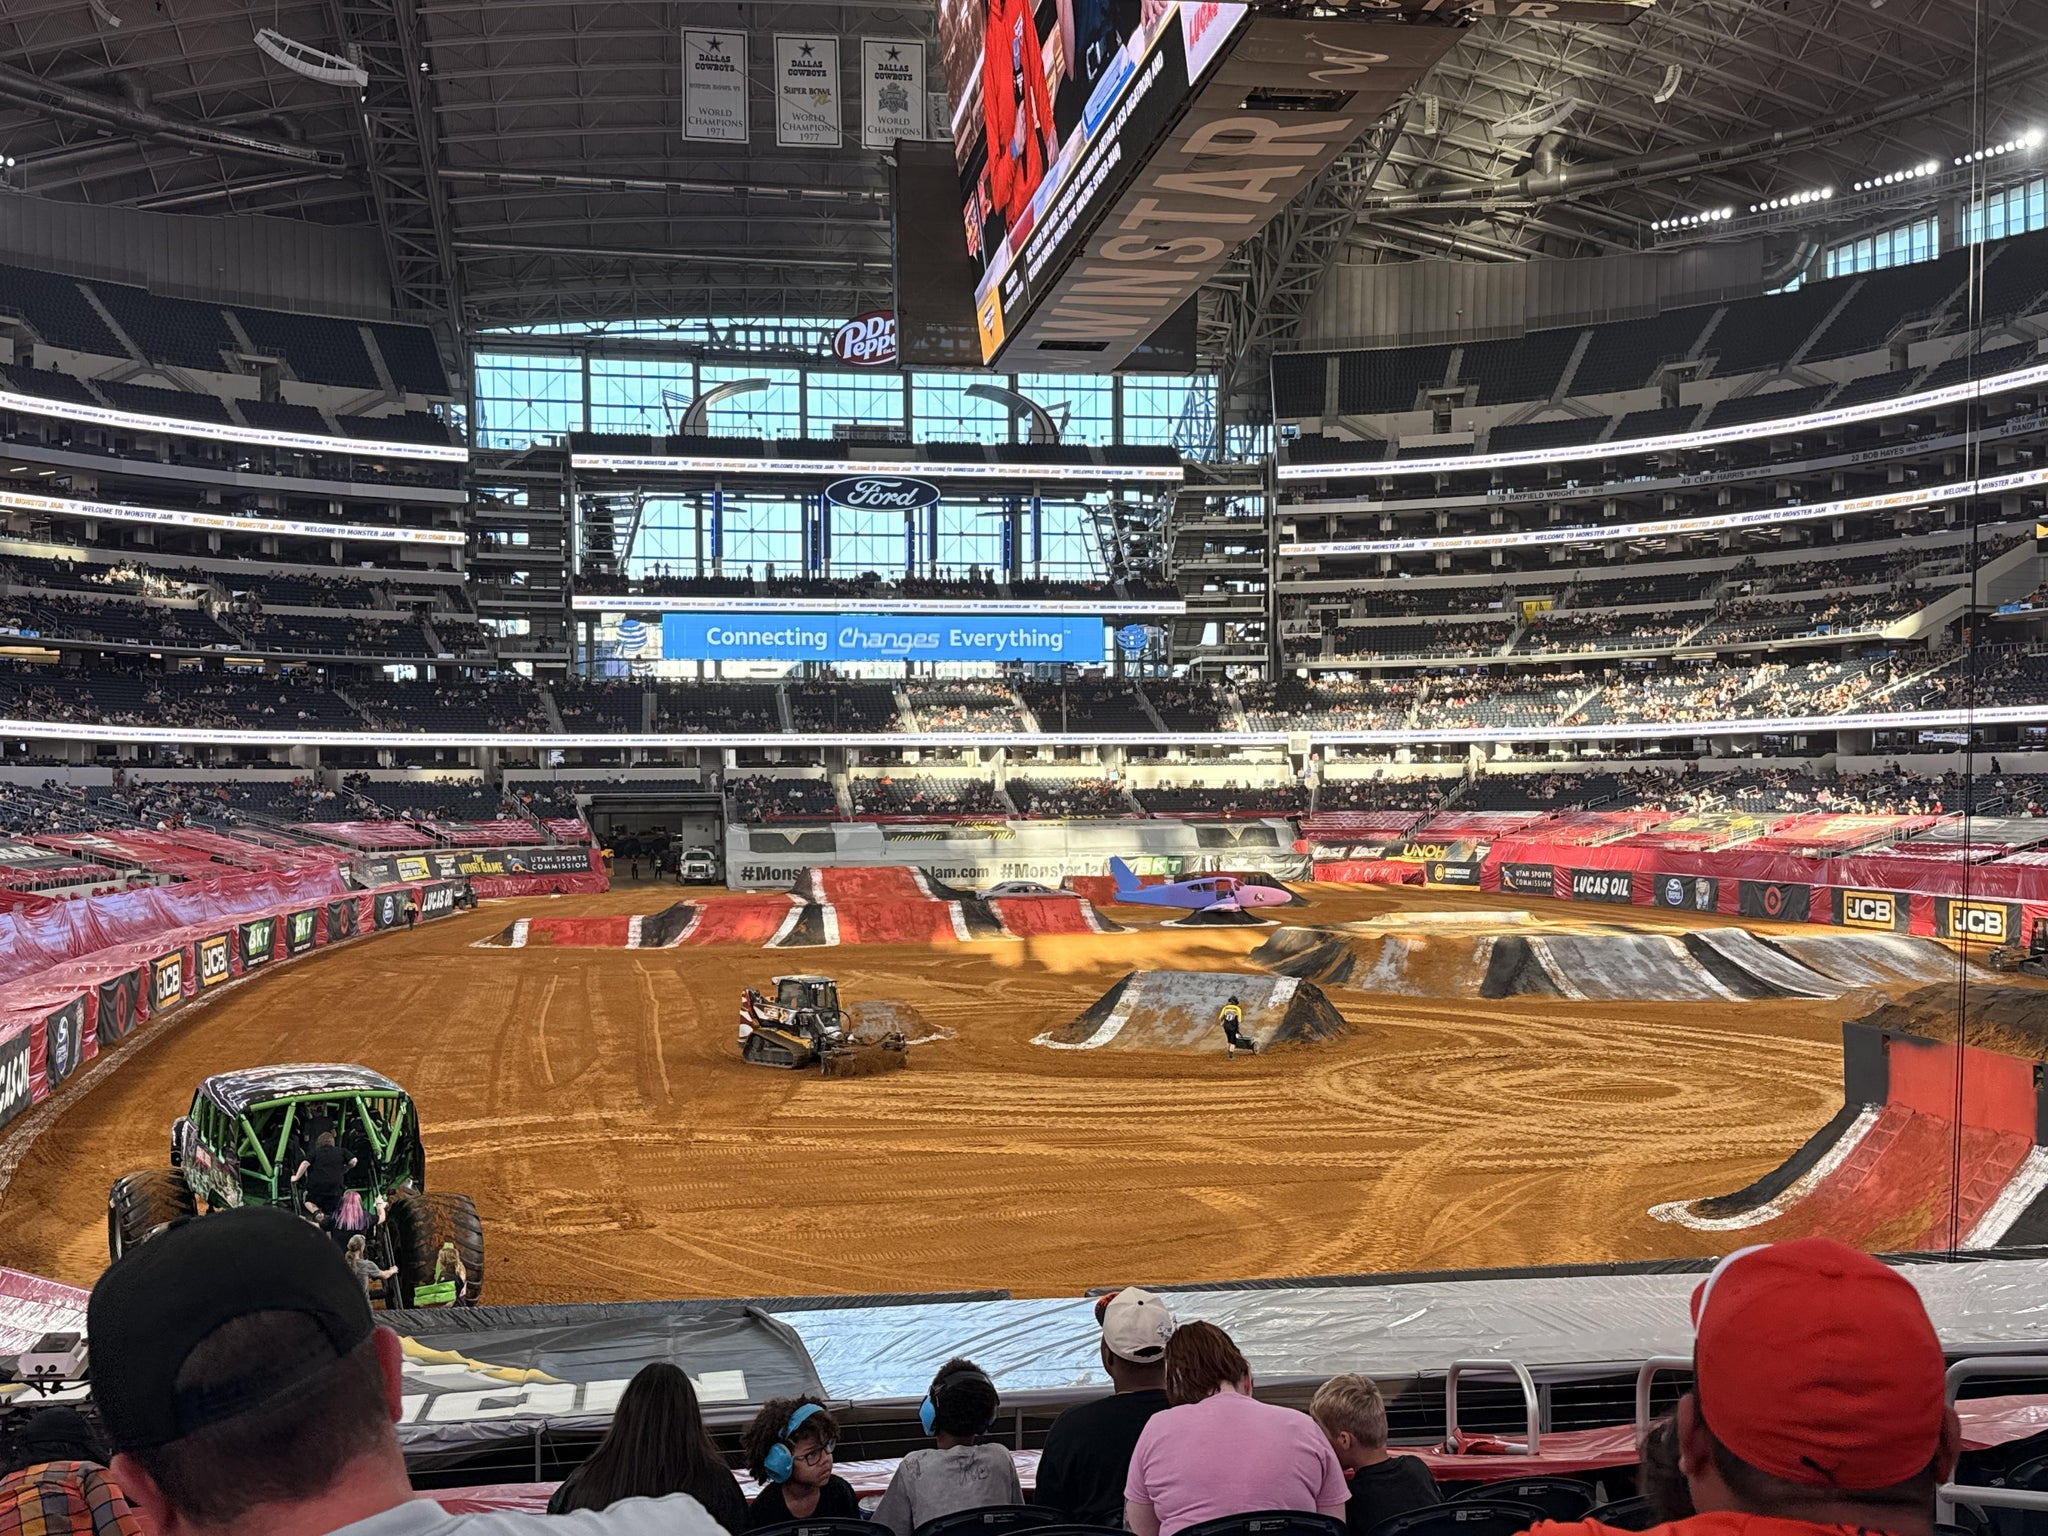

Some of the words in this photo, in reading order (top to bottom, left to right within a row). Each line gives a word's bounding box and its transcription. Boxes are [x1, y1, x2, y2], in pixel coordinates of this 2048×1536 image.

[699, 54, 731, 62] DALLAS
[1151, 47, 1163, 80] AND
[694, 62, 735, 72] COWBOYS
[792, 60, 823, 68] DALLAS
[878, 64, 909, 72] DALLAS
[788, 68, 826, 77] COWBOYS
[874, 72, 913, 81] COWBOYS
[784, 86, 806, 95] SUPER
[809, 88, 832, 96] BOWL
[698, 108, 732, 117] WORLD
[792, 112, 825, 122] WORLD
[688, 116, 743, 128] CHAMPIONS
[878, 116, 910, 126] WORLD
[706, 128, 726, 136] 1971
[782, 122, 836, 132] CHAMPIONS
[868, 125, 920, 136] CHAMPIONS
[799, 132, 819, 141] 1977
[1030, 116, 1354, 341] WINSTAR
[866, 317, 895, 339] Dr
[2012, 422, 2036, 432] RANDY
[1863, 451, 1878, 460] BOB
[1880, 448, 1905, 458] HAYES
[1694, 475, 1715, 484] CLIFF
[1717, 471, 1745, 482] HARRIS
[1943, 485, 1971, 496] WELCOME
[1981, 479, 2009, 490] MONSTER
[2011, 476, 2024, 485] JAM
[846, 480, 919, 506] Ford
[1509, 492, 1544, 501] RAYFIELD
[1547, 490, 1576, 498] WRIGHT
[82, 505, 113, 515] WELCOME
[124, 510, 157, 519] MONSTER
[158, 513, 173, 521] JAM
[1742, 513, 1771, 522] WELCOME
[1782, 508, 1812, 518] MONSTER
[304, 526, 336, 535] WELCOME
[347, 528, 379, 537] MONSTER
[380, 530, 395, 538] JAM
[1535, 533, 1565, 541] WELCOME
[1576, 530, 1604, 538] MONSTER
[706, 627, 827, 650] Connecting
[838, 629, 940, 654] Changes
[473, 854, 484, 863] THE
[459, 863, 481, 873] VIDEO
[482, 862, 504, 872] GAME
[532, 862, 588, 870] COMMISSION
[1516, 870, 1530, 878] UTAH
[1531, 871, 1552, 879] SPORTS
[1516, 879, 1551, 887] COMMISSION
[1573, 875, 1609, 895] LUCAS
[1610, 878, 1630, 896] OIL
[422, 890, 444, 911] LUCAS
[1852, 899, 1892, 922] JCB
[296, 917, 312, 937] BKT
[1956, 909, 2003, 935] JCB
[249, 927, 269, 948] BKT
[203, 947, 226, 976] JCB
[159, 964, 179, 997] JCB
